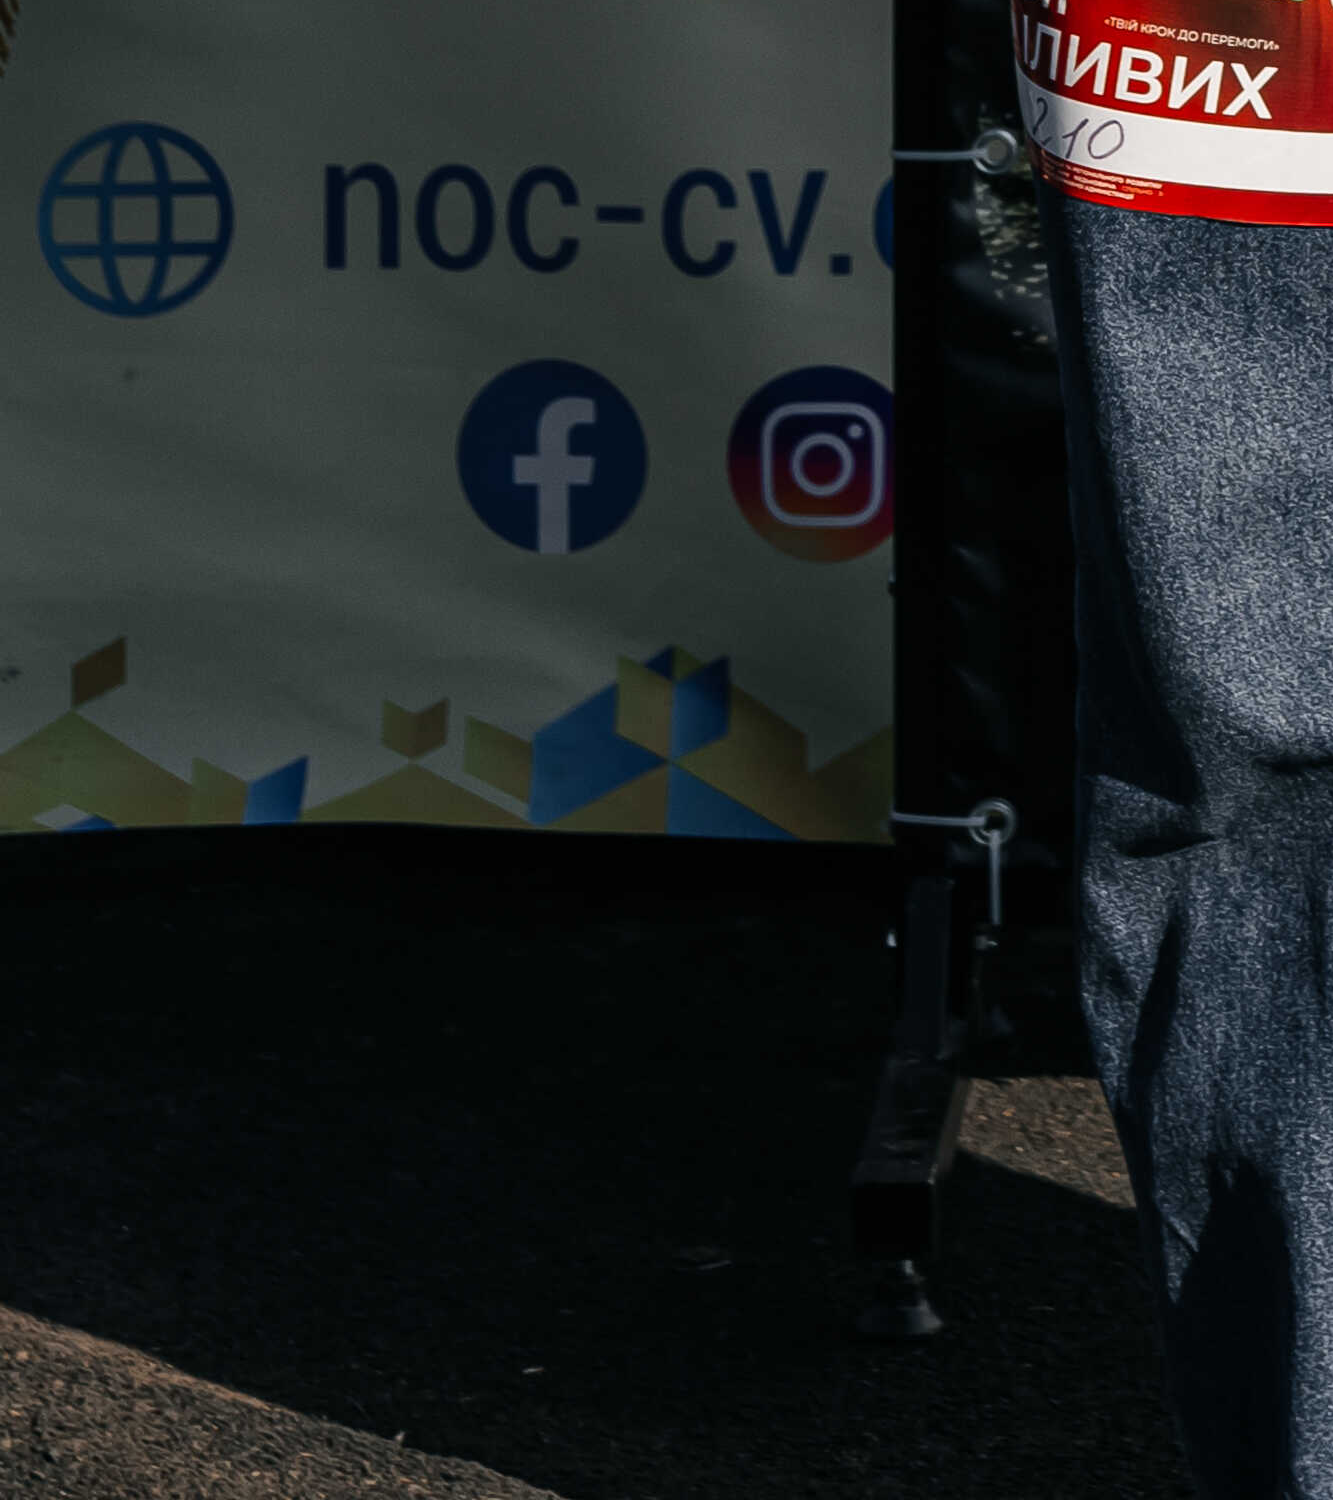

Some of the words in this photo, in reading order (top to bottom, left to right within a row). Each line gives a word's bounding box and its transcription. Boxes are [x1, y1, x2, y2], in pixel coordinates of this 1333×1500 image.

[1140, 23, 1176, 39] КРОК
[1177, 29, 1199, 43] ДО
[323, 161, 894, 279] noc-cv.
